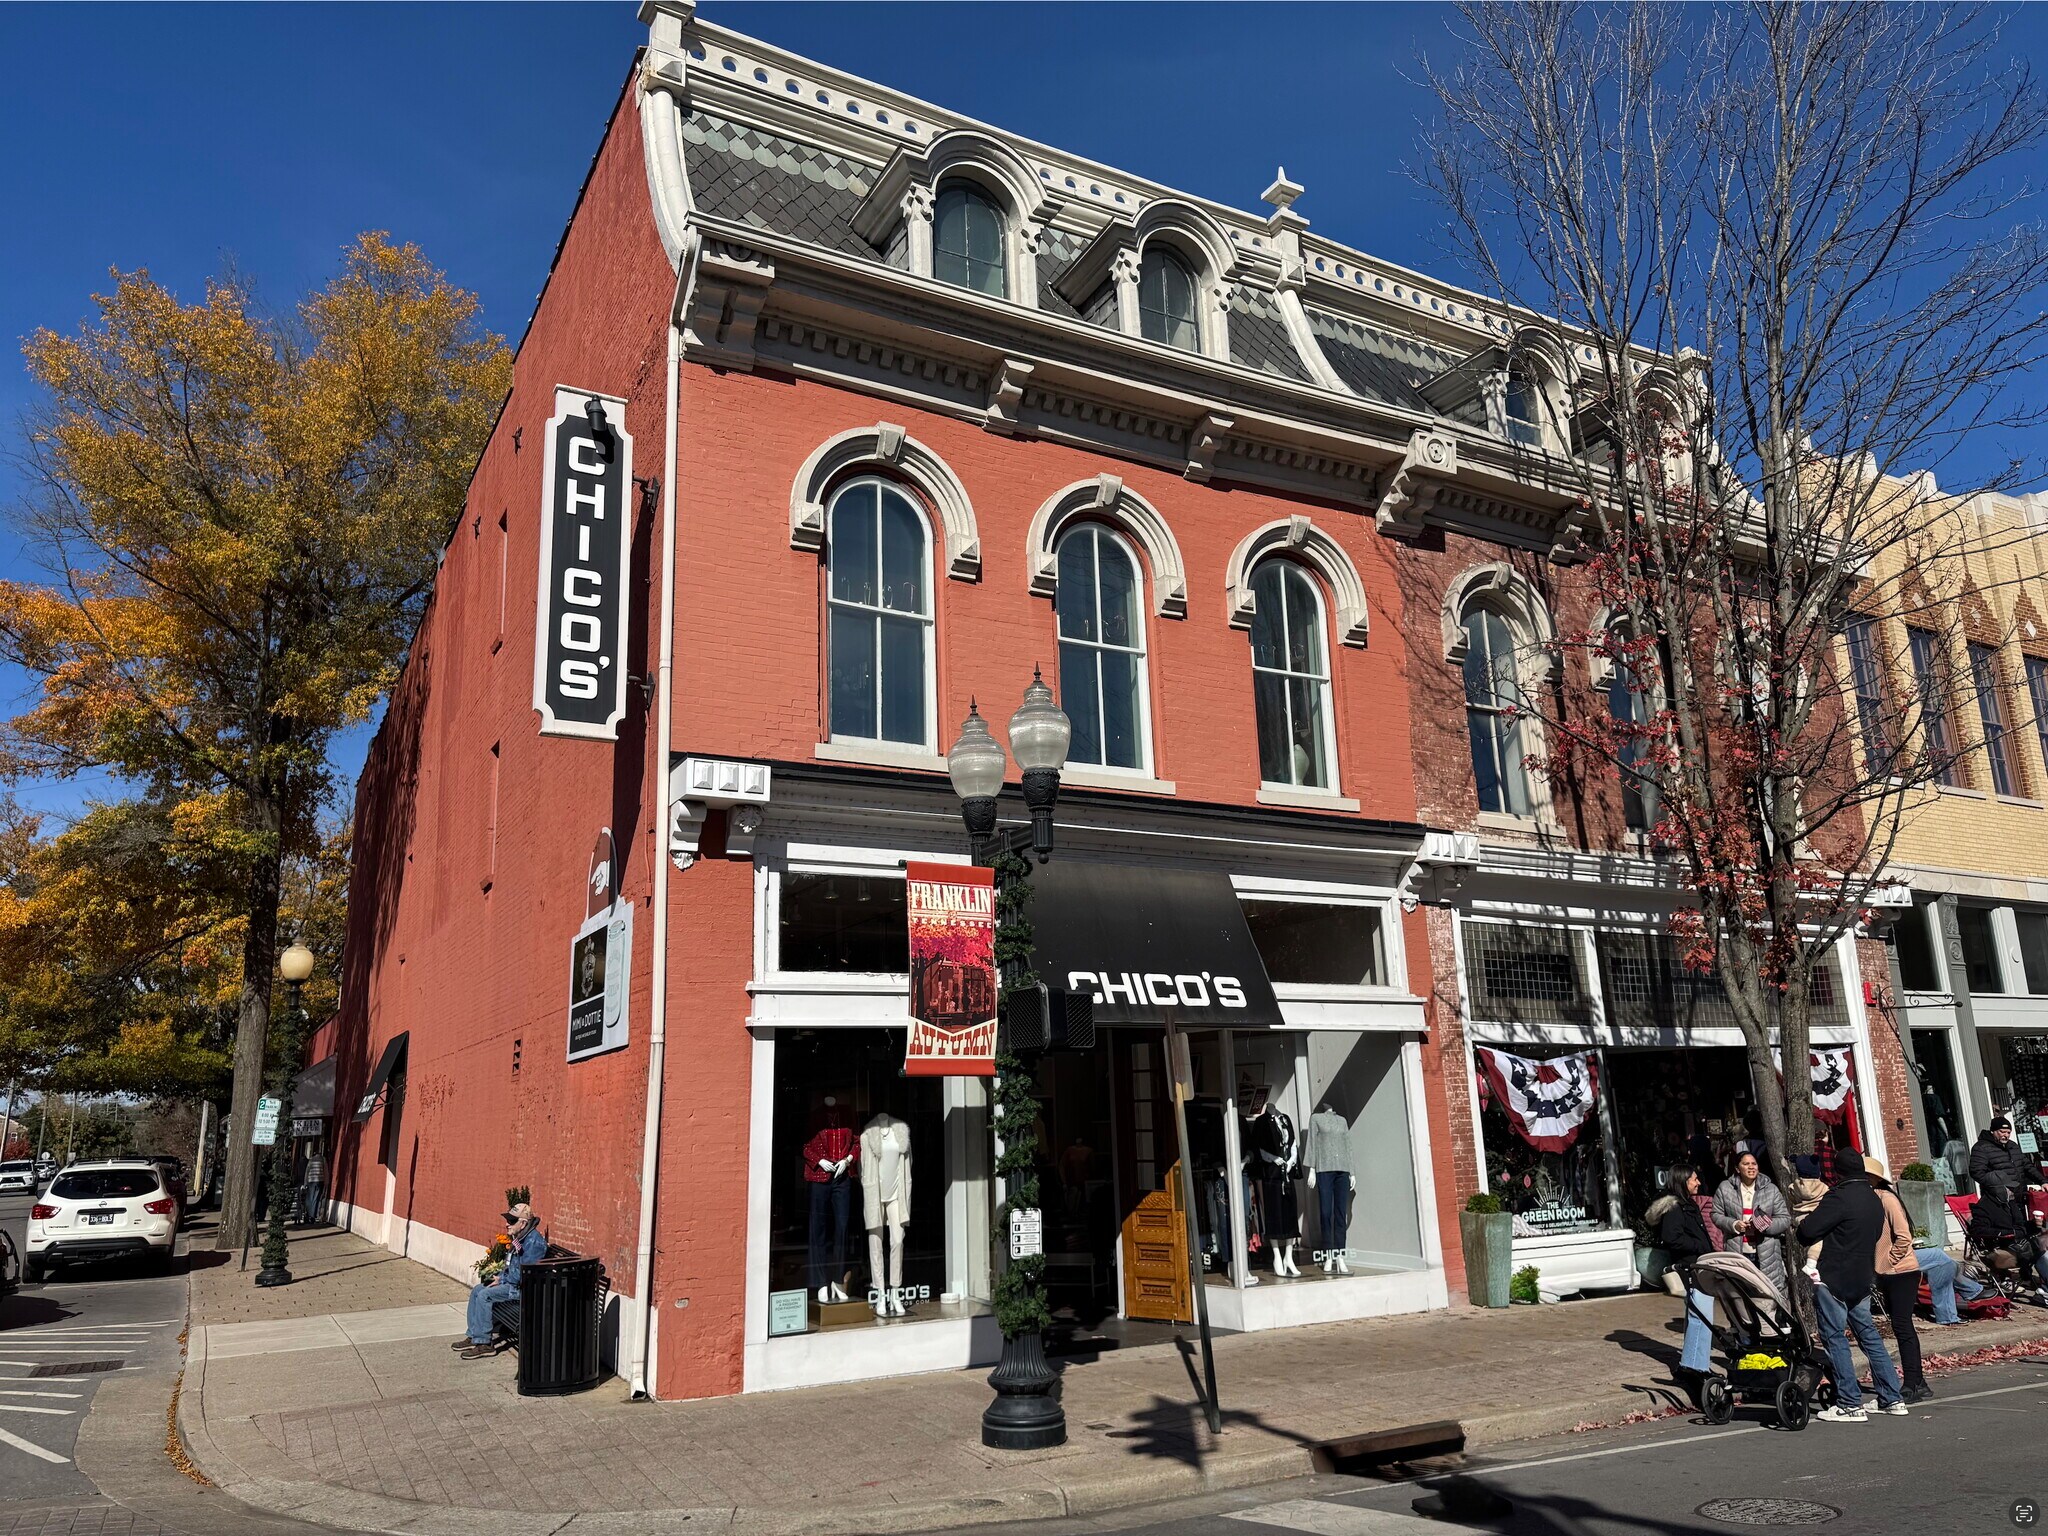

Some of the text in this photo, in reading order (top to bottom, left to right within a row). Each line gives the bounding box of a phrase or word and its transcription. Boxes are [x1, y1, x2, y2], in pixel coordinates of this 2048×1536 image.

[559, 435, 609, 700] CHICO'S
[910, 882, 992, 914] FRANKLIN
[911, 917, 992, 930] TENNESSEE
[1068, 971, 1248, 1008] CHICO'S
[909, 1021, 995, 1056] AUTUMN
[259, 1101, 266, 1109] 2
[1522, 1206, 1586, 1222] GREEN ROOM
[1546, 1201, 1559, 1209] THE
[868, 1284, 930, 1304] CHICO'S
